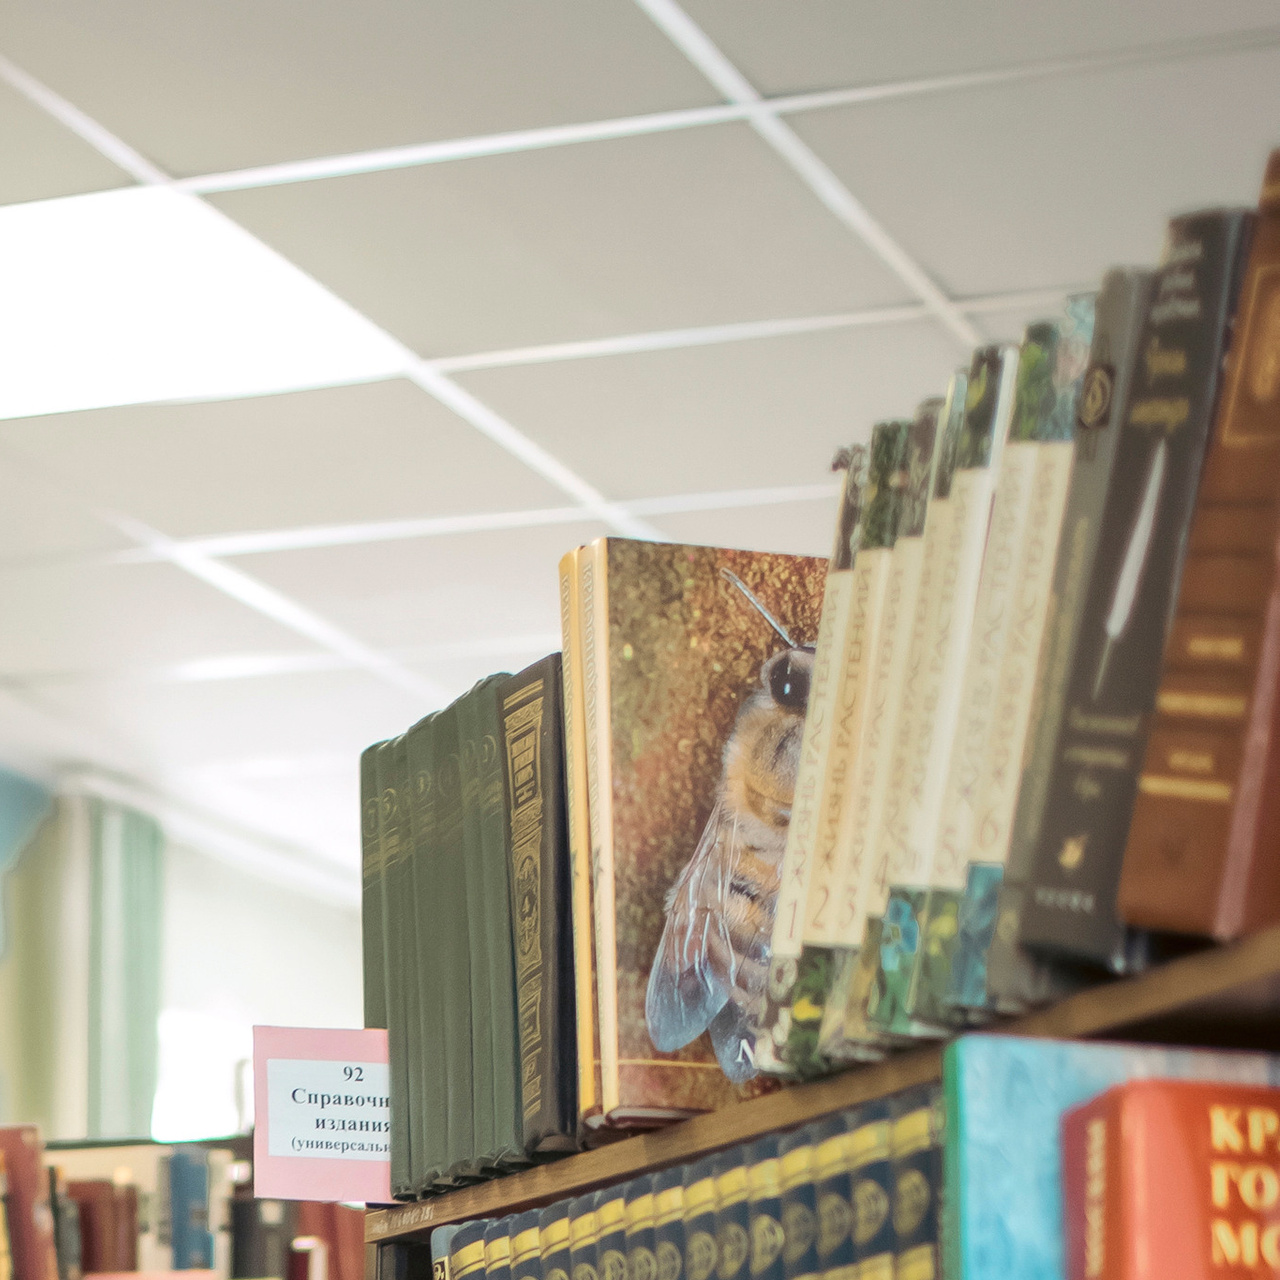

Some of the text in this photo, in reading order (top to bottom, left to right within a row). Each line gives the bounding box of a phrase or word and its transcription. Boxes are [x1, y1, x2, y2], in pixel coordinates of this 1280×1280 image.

[342, 1065, 365, 1082] 92
[291, 1087, 390, 1109] Справочн
[314, 1117, 391, 1132] издания
[1209, 1105, 1280, 1153] КР
[291, 1136, 391, 1153] (универсальн
[1210, 1163, 1280, 1211] ГО
[1211, 1219, 1280, 1267] МО
